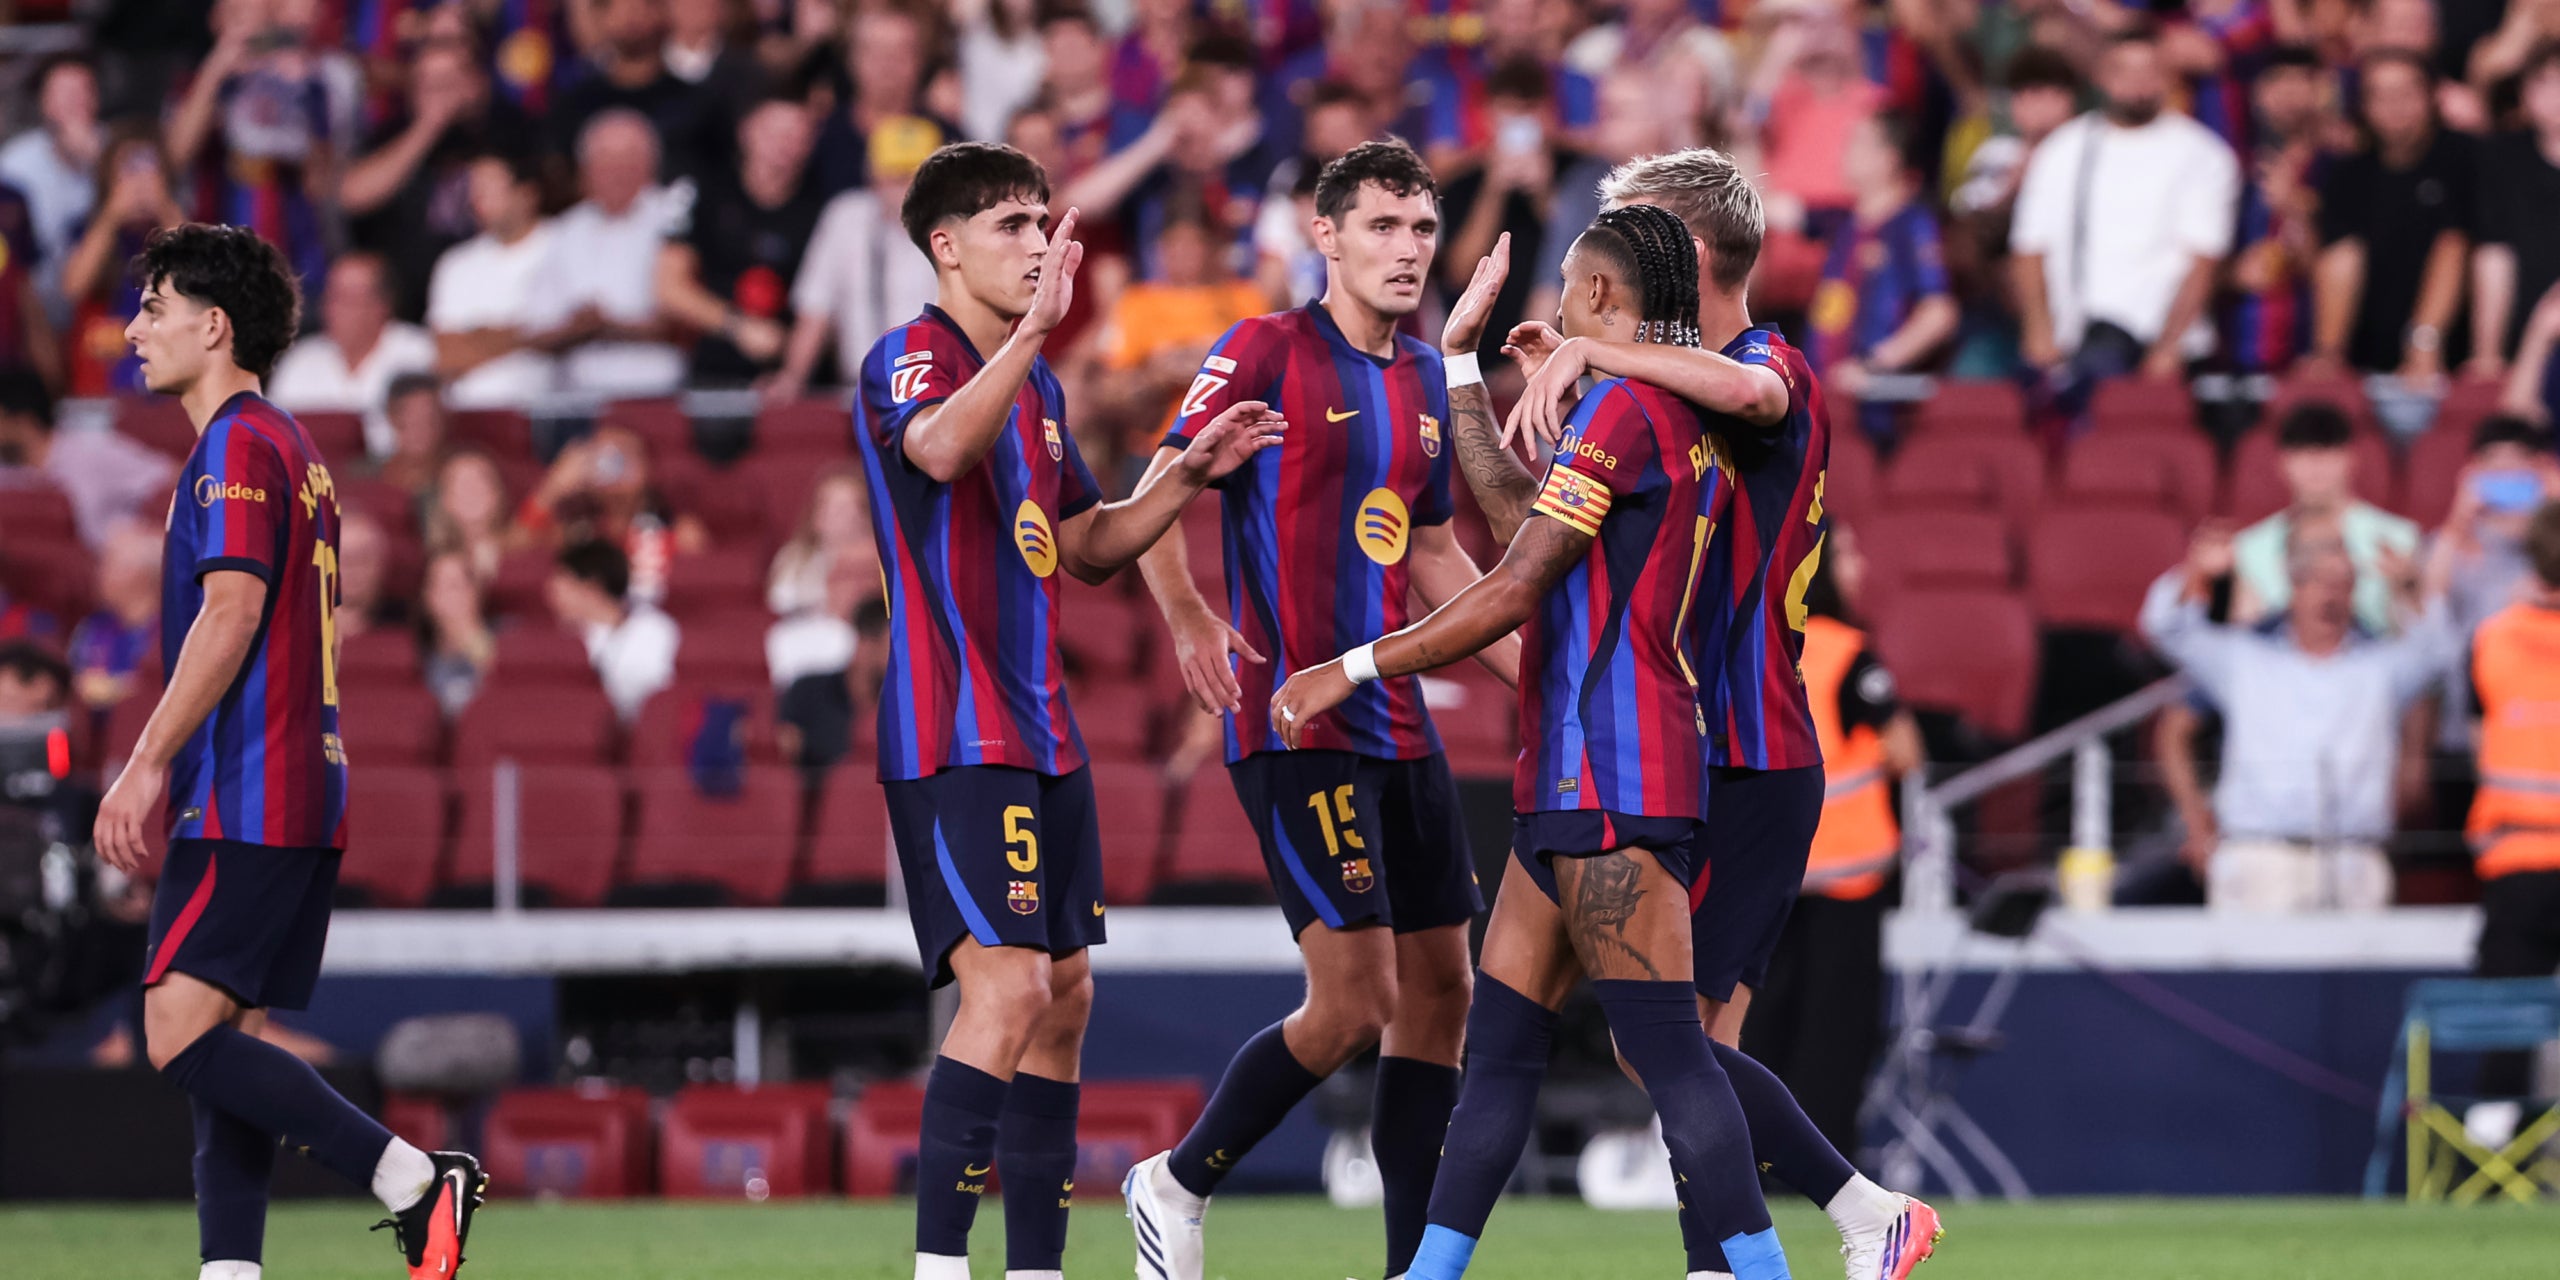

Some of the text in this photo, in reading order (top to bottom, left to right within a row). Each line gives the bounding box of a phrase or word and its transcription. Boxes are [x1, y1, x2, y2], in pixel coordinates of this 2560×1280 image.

[1554, 424, 1618, 471] Midea
[195, 474, 266, 508] Midea
[1003, 805, 1039, 873] 5
